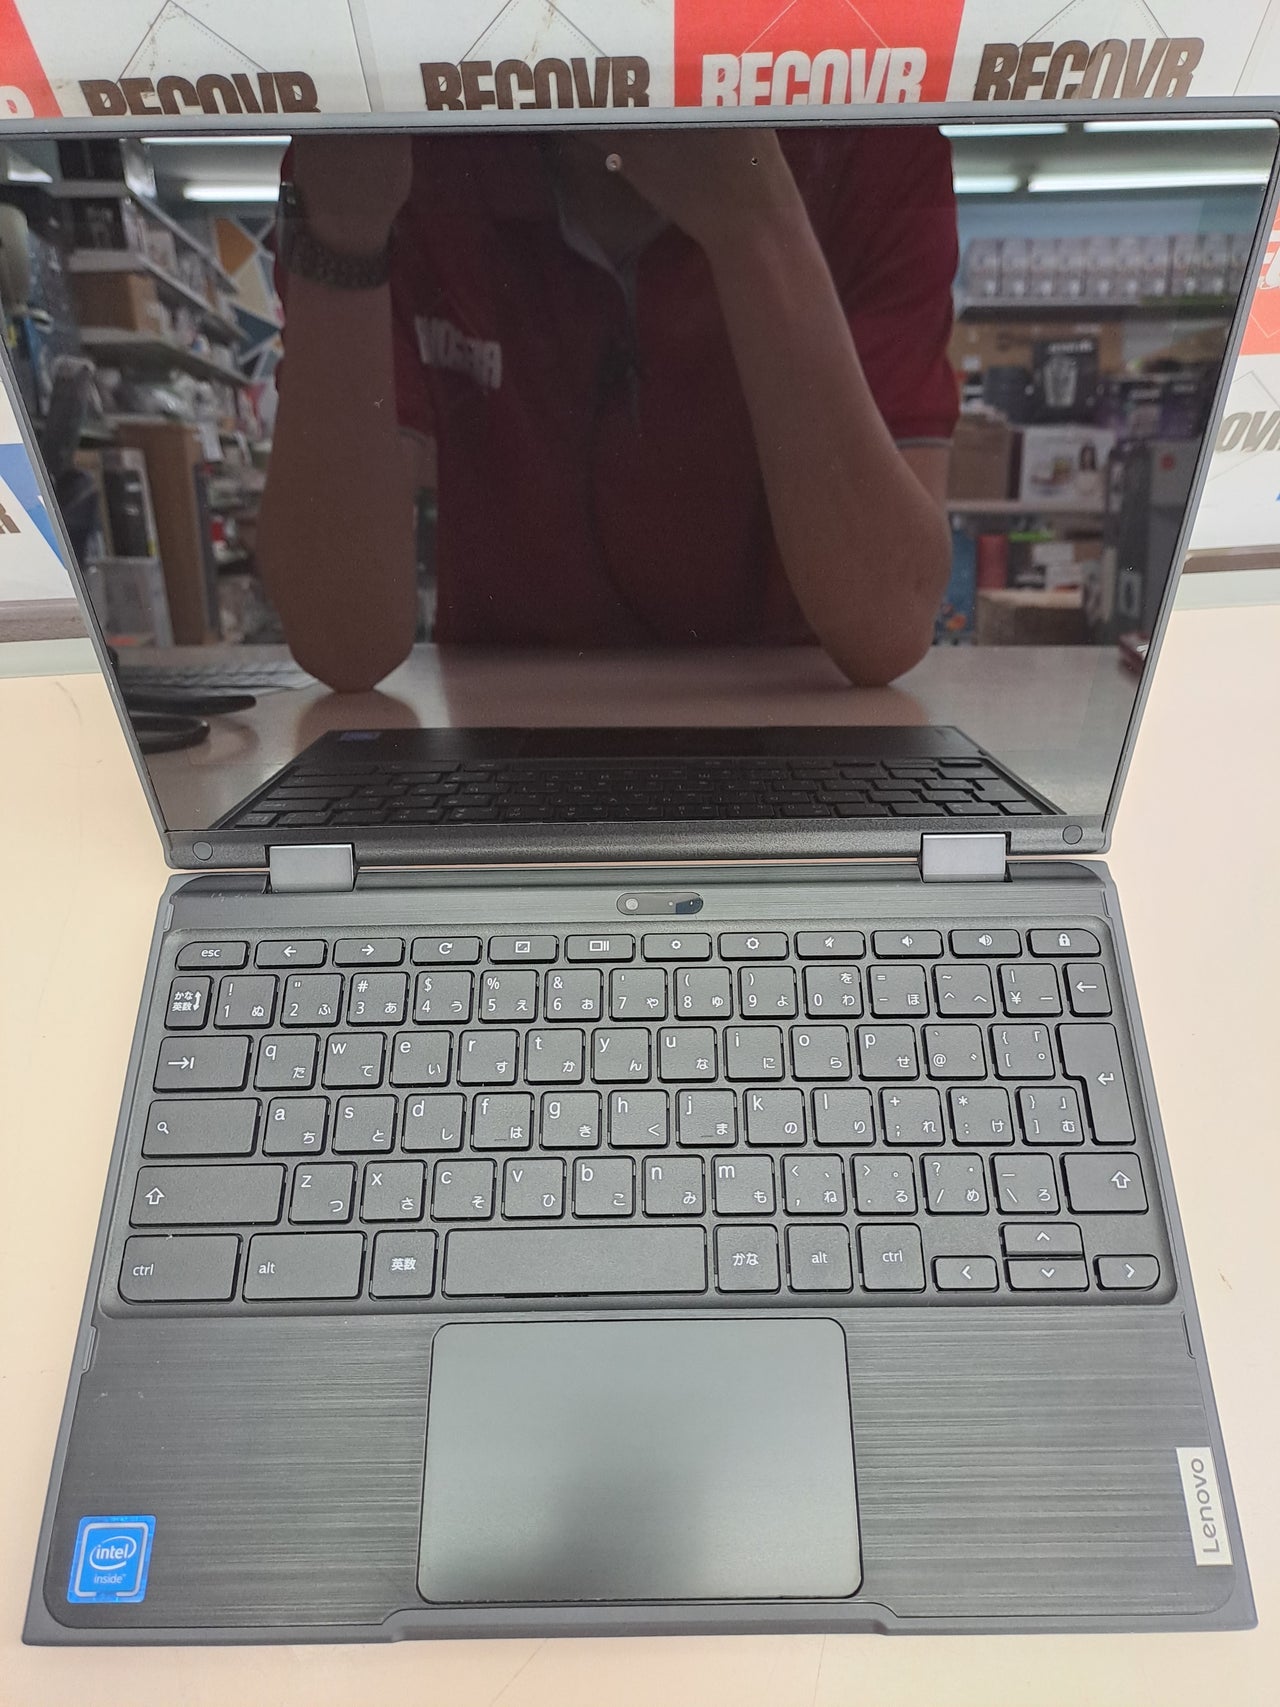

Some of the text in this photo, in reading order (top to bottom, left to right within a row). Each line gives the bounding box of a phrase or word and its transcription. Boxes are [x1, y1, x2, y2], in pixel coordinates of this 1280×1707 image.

[487, 977, 499, 989] %
[553, 977, 563, 989] &
[841, 973, 852, 983] を
[357, 980, 368, 992] #
[424, 978, 432, 992] $
[174, 991, 193, 1000] かな
[749, 995, 788, 1007] 9 よ
[842, 995, 855, 1005] わ
[908, 994, 920, 1005] ほ
[1010, 992, 1021, 1004] ¥
[356, 1002, 397, 1014] 3 あ
[422, 1000, 462, 1012] 4 う
[488, 999, 528, 1011] 5 え
[554, 998, 593, 1010] 6 お
[619, 997, 659, 1009] 7 や
[684, 996, 723, 1008] 8 ゆ
[252, 1006, 264, 1016] ぬ
[290, 1003, 331, 1016] 2 ふ
[535, 1037, 542, 1050] t
[666, 1037, 676, 1048] u
[799, 1035, 809, 1046] o
[865, 1034, 875, 1049] p
[1002, 1032, 1008, 1044] {
[332, 1043, 347, 1054] w
[400, 1042, 411, 1053] e
[469, 1040, 476, 1052] r
[600, 1038, 610, 1052] y
[266, 1045, 276, 1060] q
[563, 1061, 575, 1072] か
[630, 1060, 642, 1071] ん
[696, 1058, 708, 1070] な
[763, 1058, 775, 1069] に
[830, 1057, 842, 1068] ら
[897, 1056, 910, 1068] せ
[933, 1054, 946, 1067] @
[293, 1067, 305, 1078] た
[362, 1066, 373, 1076] て
[429, 1064, 441, 1075] い
[496, 1061, 508, 1073] す
[482, 1098, 489, 1114] f
[618, 1097, 628, 1113] h
[753, 1095, 763, 1111] k
[890, 1097, 900, 1106] +
[275, 1109, 285, 1120] a
[345, 1107, 354, 1118] s
[413, 1100, 424, 1117] d
[549, 1102, 560, 1119] g
[579, 1125, 591, 1137] き
[717, 1123, 728, 1135] ま
[785, 1122, 797, 1134] の
[854, 1121, 865, 1133] り
[923, 1121, 936, 1133] れ
[992, 1120, 1004, 1132] け
[1062, 1120, 1075, 1132] む
[303, 1132, 315, 1144] ち
[372, 1130, 384, 1142] と
[442, 1128, 453, 1140] し
[510, 1127, 522, 1139] は
[582, 1164, 593, 1181] b
[652, 1167, 662, 1180] n
[719, 1166, 735, 1178] m
[792, 1166, 798, 1176] <
[864, 1165, 870, 1176] >
[932, 1162, 941, 1176] ?
[301, 1175, 312, 1187] z
[371, 1173, 382, 1185] x
[441, 1172, 452, 1184] c
[513, 1170, 523, 1182] v
[543, 1194, 556, 1207] ひ
[614, 1193, 625, 1206] こ
[683, 1192, 696, 1204] み
[754, 1191, 767, 1203] も
[824, 1191, 837, 1203] ね
[896, 1190, 908, 1202] る
[937, 1189, 979, 1203] / め
[1039, 1189, 1050, 1201] ろ
[330, 1200, 343, 1212] つ
[402, 1197, 413, 1210] さ
[472, 1196, 484, 1208] そ
[733, 1253, 759, 1266] かな
[812, 1252, 828, 1263] alt
[883, 1250, 903, 1262] ctrl
[133, 1264, 154, 1276] ctrl
[259, 1262, 275, 1274] alt
[391, 1257, 416, 1271] 英数
[1191, 1458, 1220, 1553] Lenovo
[96, 1543, 129, 1560] intel
